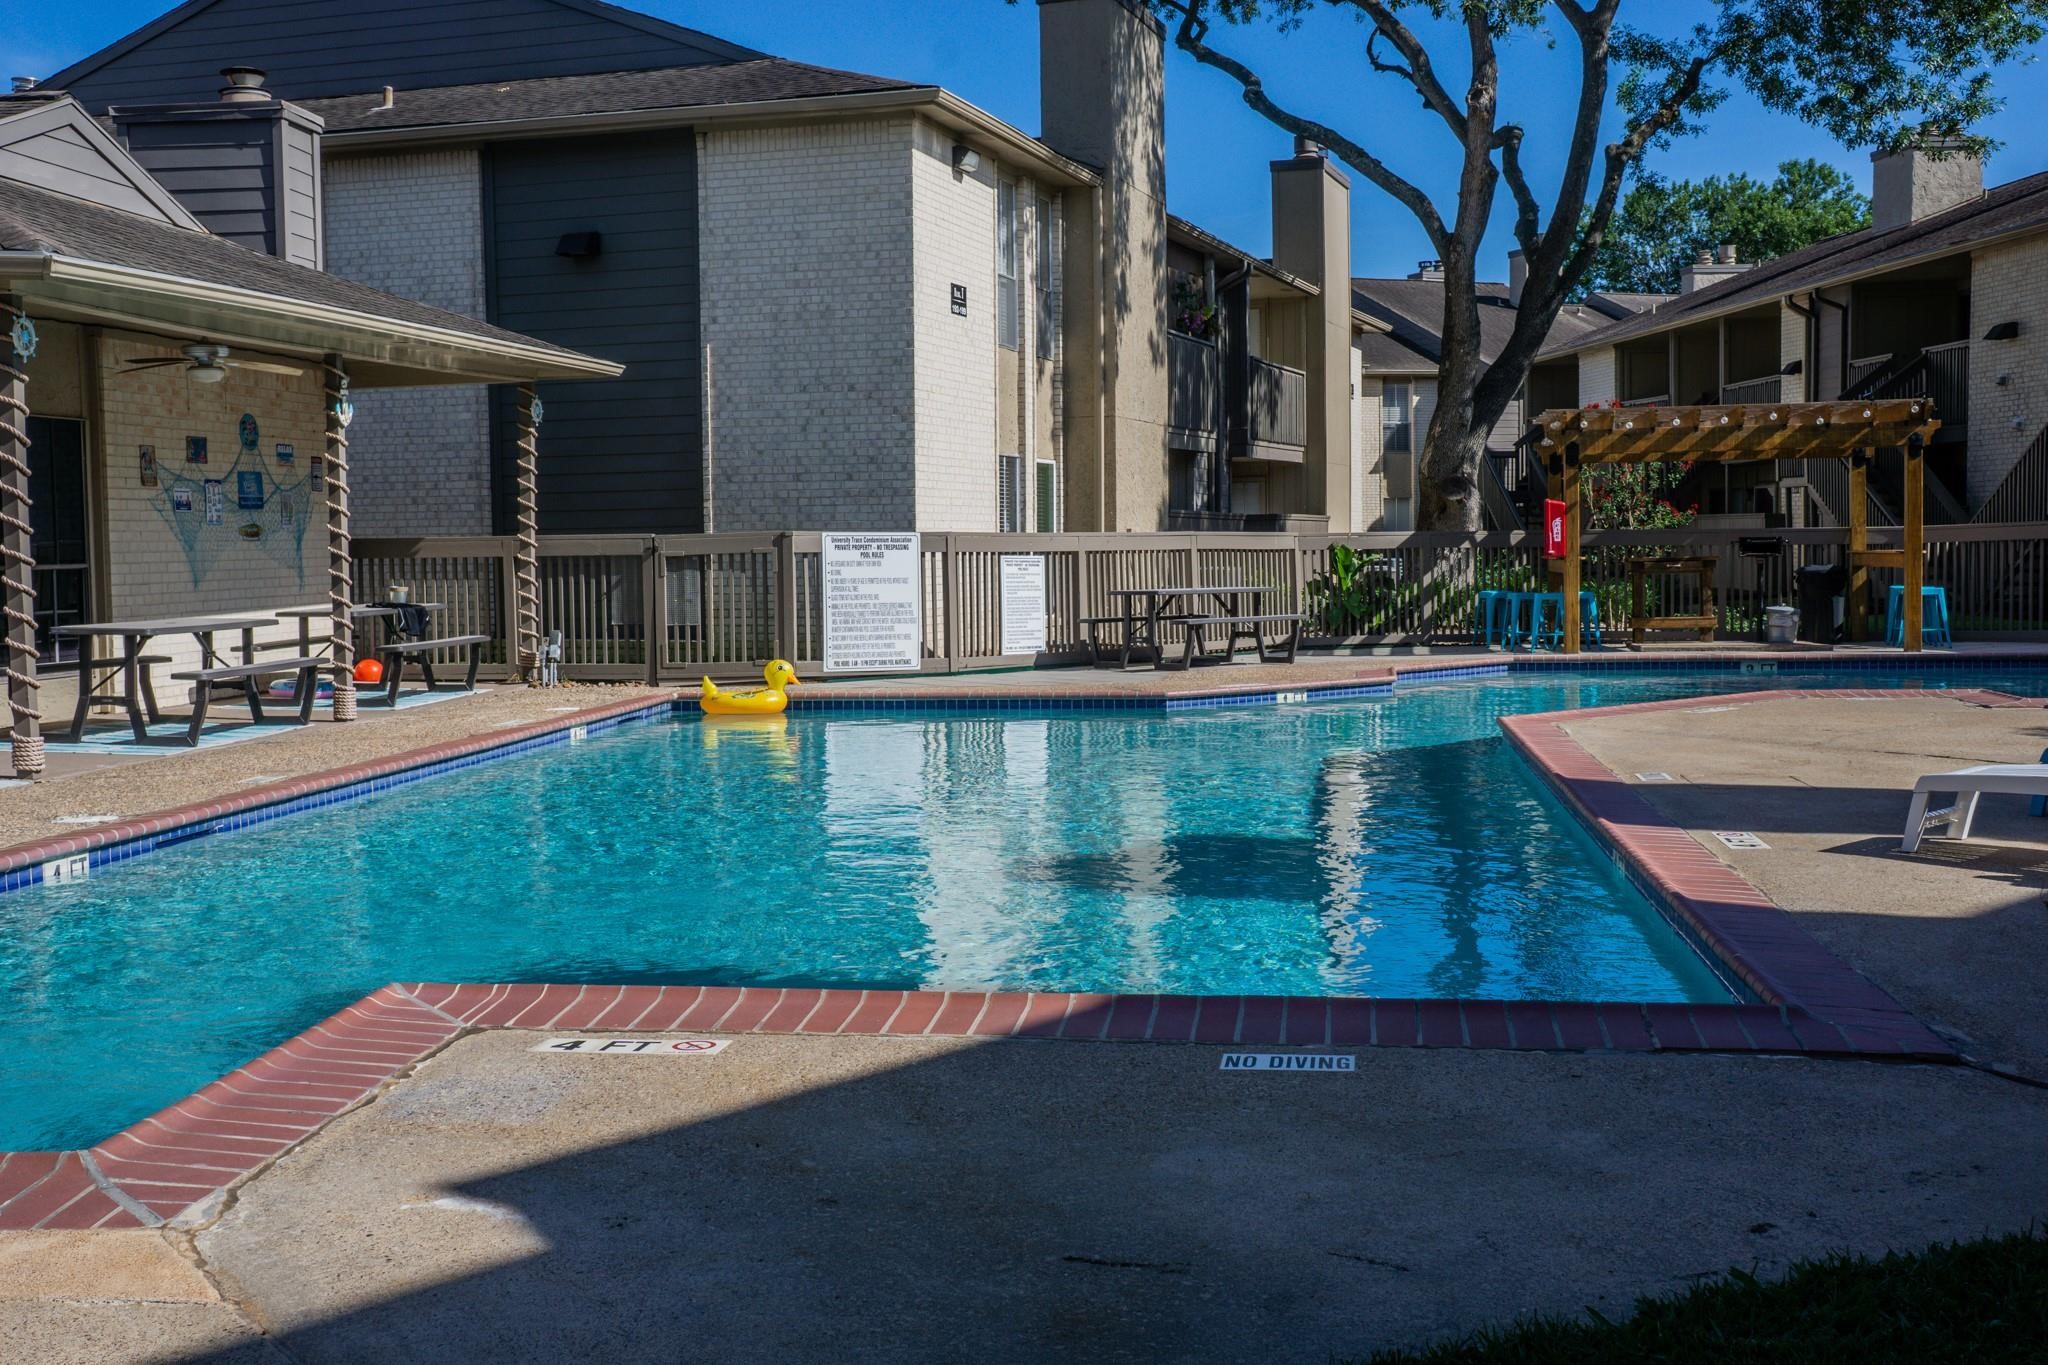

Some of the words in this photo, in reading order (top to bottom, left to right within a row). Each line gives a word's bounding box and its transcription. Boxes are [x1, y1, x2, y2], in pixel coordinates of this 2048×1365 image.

[551, 1040, 587, 1051] 4
[599, 1040, 662, 1052] FT
[1224, 1055, 1257, 1068] NO
[1269, 1055, 1350, 1069] DIVING
